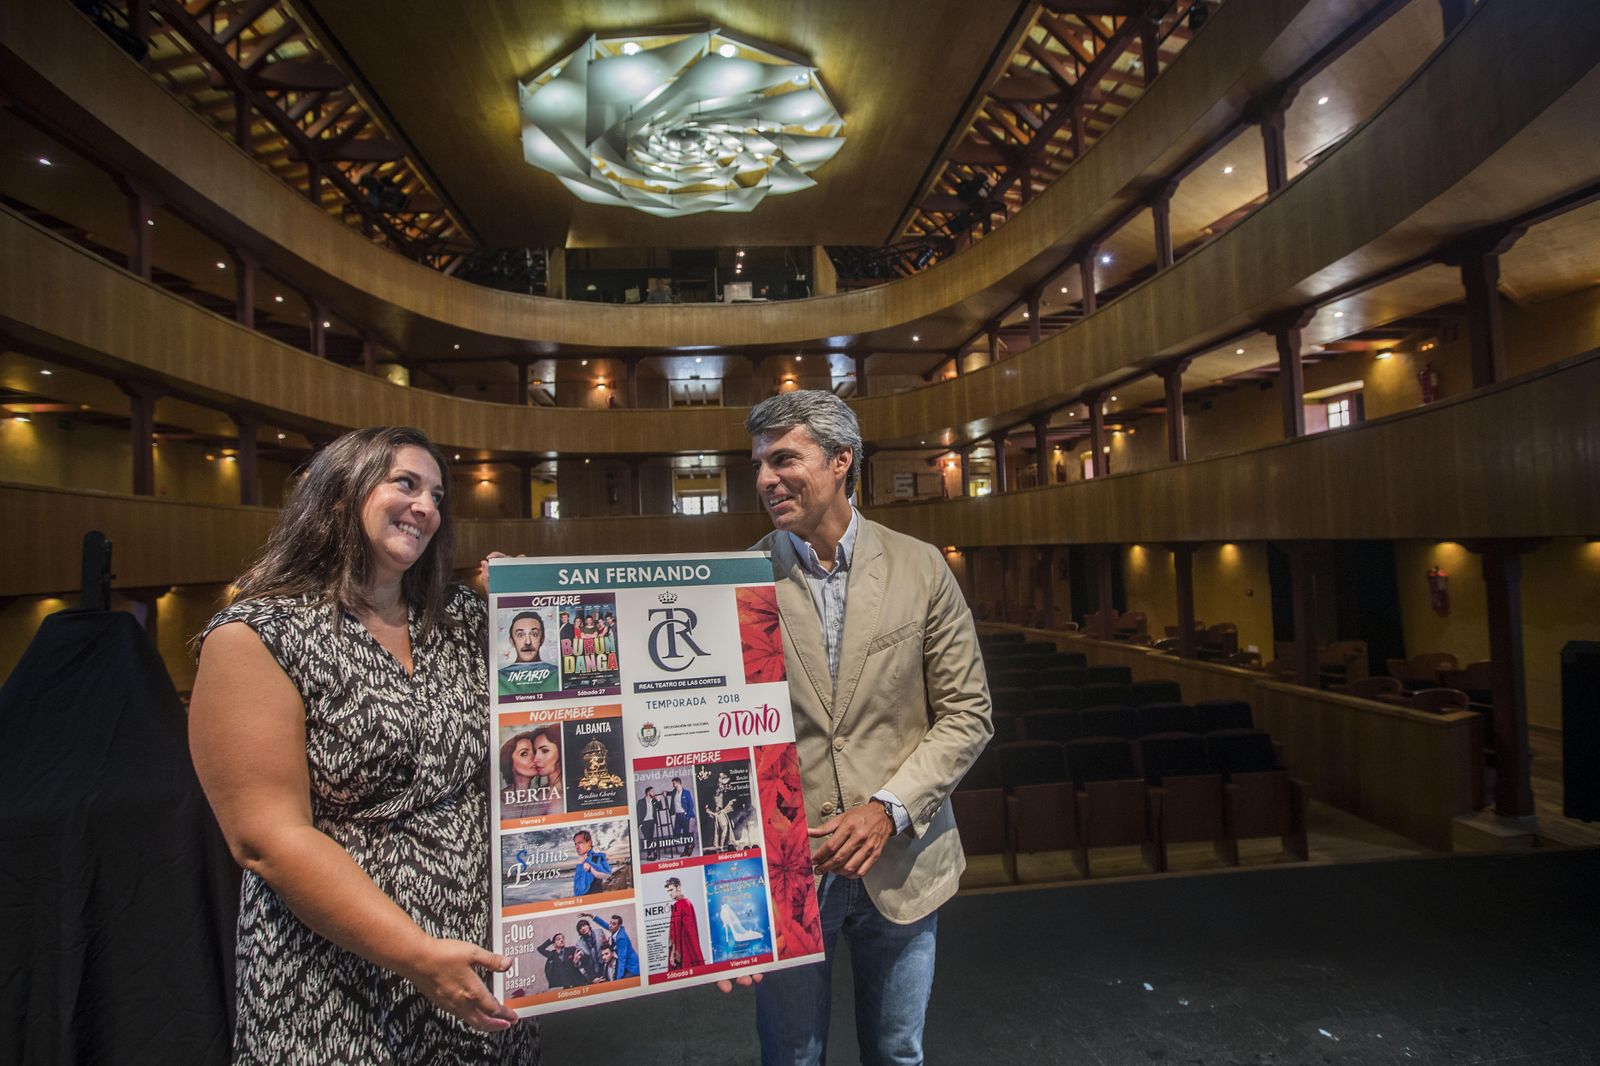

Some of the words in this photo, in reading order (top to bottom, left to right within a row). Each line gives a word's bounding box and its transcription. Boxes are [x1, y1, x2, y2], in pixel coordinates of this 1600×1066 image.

[558, 568, 599, 585] SAN
[606, 564, 711, 584] FERNANDO
[531, 595, 581, 607] OCTUBRE
[561, 634, 616, 656] BURUN
[564, 652, 618, 674] DANGA
[507, 669, 551, 682] INFARTO
[655, 681, 678, 689] TEATRO
[698, 677, 722, 685] CORTES
[646, 696, 707, 710] TEMPORADA
[717, 694, 740, 705] 2018
[529, 706, 596, 721] NOVIEMBRE
[717, 703, 781, 738] OTOÑO
[575, 722, 612, 736] ALBANTA
[665, 750, 722, 767] DICIEMBRE
[633, 770, 661, 782] David
[504, 786, 561, 805] BERTA
[643, 839, 657, 850] Lo
[659, 836, 694, 848] nuestro
[506, 862, 561, 889] Esteros
[504, 920, 534, 944] ¿Qué
[730, 959, 750, 968] Viernes
